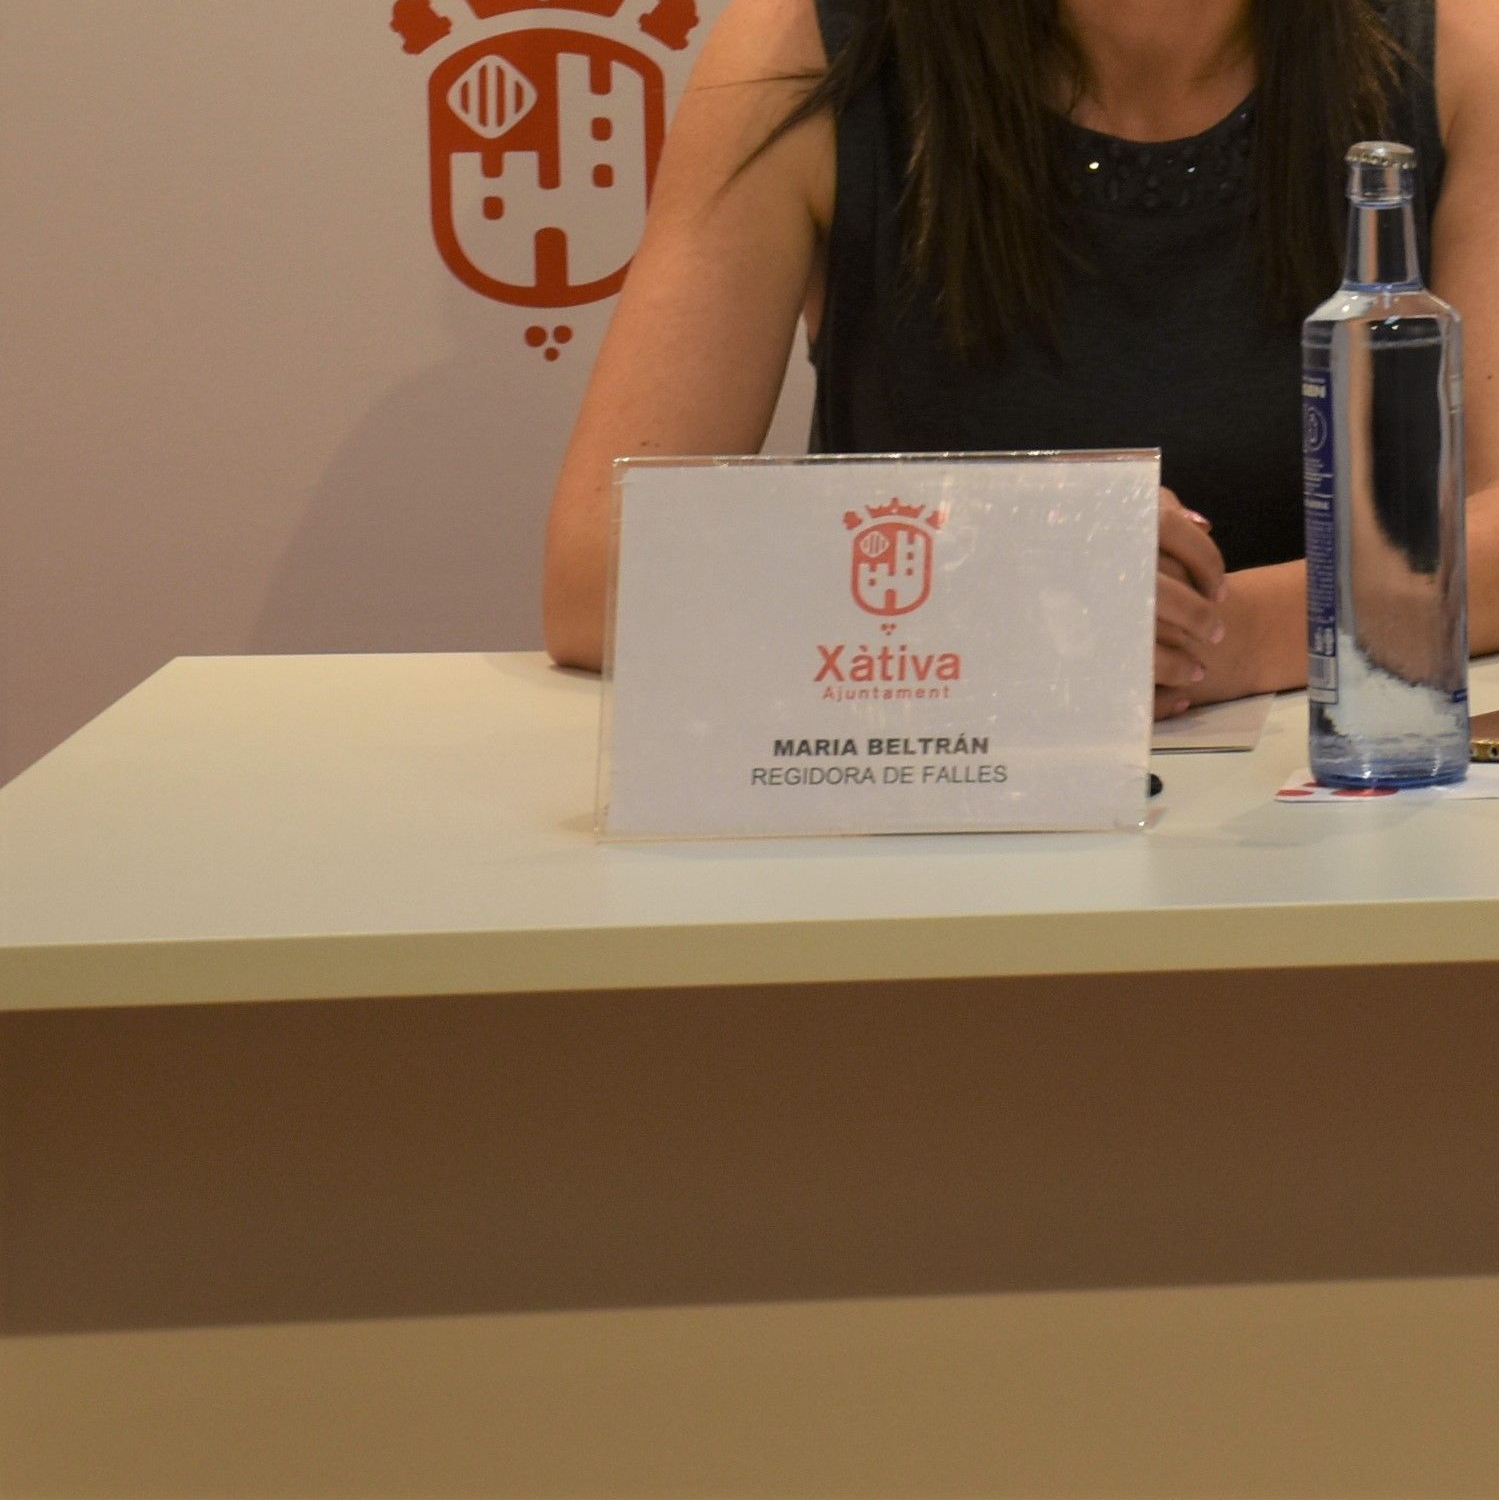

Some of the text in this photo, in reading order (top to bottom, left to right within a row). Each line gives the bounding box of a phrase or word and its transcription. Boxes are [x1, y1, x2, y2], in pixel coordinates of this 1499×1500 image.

[813, 643, 963, 684] Xàtiva
[821, 685, 951, 702] Ajuntament
[773, 732, 989, 757] MARIA BELTRÁN
[750, 764, 1008, 786] REGIDORA DE FALLES
